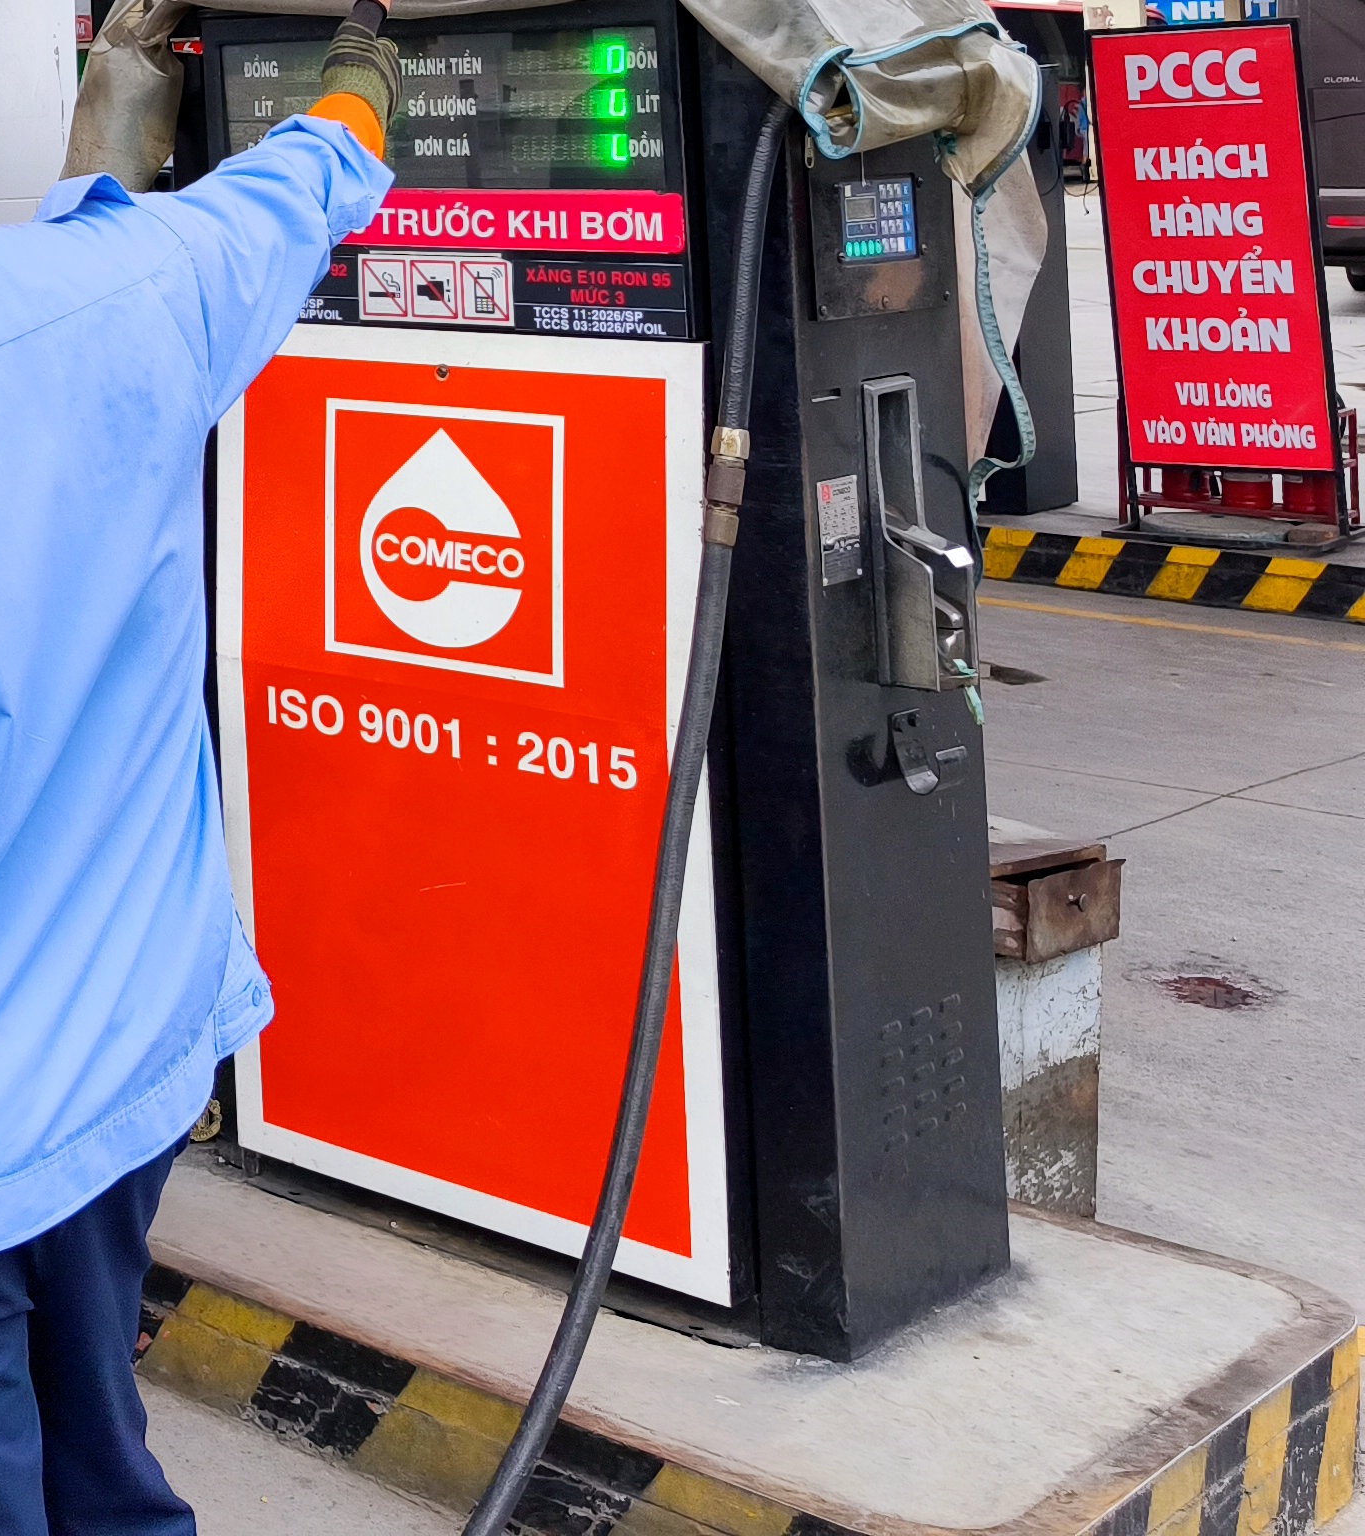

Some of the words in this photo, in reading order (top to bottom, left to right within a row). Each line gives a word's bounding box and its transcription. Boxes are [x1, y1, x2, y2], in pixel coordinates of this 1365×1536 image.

[243, 54, 279, 78] ĐỒNG
[401, 54, 447, 76] THÀNH
[451, 50, 482, 75] TIỀN
[1124, 46, 1262, 102] PCCC
[1323, 75, 1363, 84] GLOBAL
[254, 96, 273, 117] LÍT
[407, 91, 427, 117] SỐ
[430, 96, 476, 121] LƯỢNG
[414, 136, 444, 157] ĐƠN
[446, 133, 470, 157] GIÁ
[1133, 137, 1269, 182] KHÁCH
[378, 202, 495, 239] TRƯỚC
[508, 210, 568, 240] KHI
[580, 207, 664, 243] BƠM
[1149, 199, 1263, 238] HÀNG
[526, 266, 573, 284] XĂNG
[577, 269, 607, 286] E10
[611, 270, 648, 287] RON
[652, 272, 671, 287] 95
[1132, 244, 1296, 296] CHUYỂN
[570, 285, 610, 305] MỨC
[615, 290, 626, 305] 3
[533, 305, 567, 319] TCCS
[573, 307, 644, 323] 11:2026/SP
[533, 317, 569, 331] TCCS
[573, 319, 667, 336] 03:2026/PVOIL
[1145, 306, 1291, 353] KHOẢN
[1174, 380, 1210, 407] VUI
[1214, 377, 1273, 409] LÒNG
[1143, 419, 1186, 447] VÀO
[1192, 414, 1236, 448] VĂN
[1241, 418, 1316, 450] PHÒNG
[374, 530, 526, 579] COMECO
[267, 685, 345, 735] ISO
[359, 701, 464, 762] 9001
[517, 730, 639, 791] 2015
